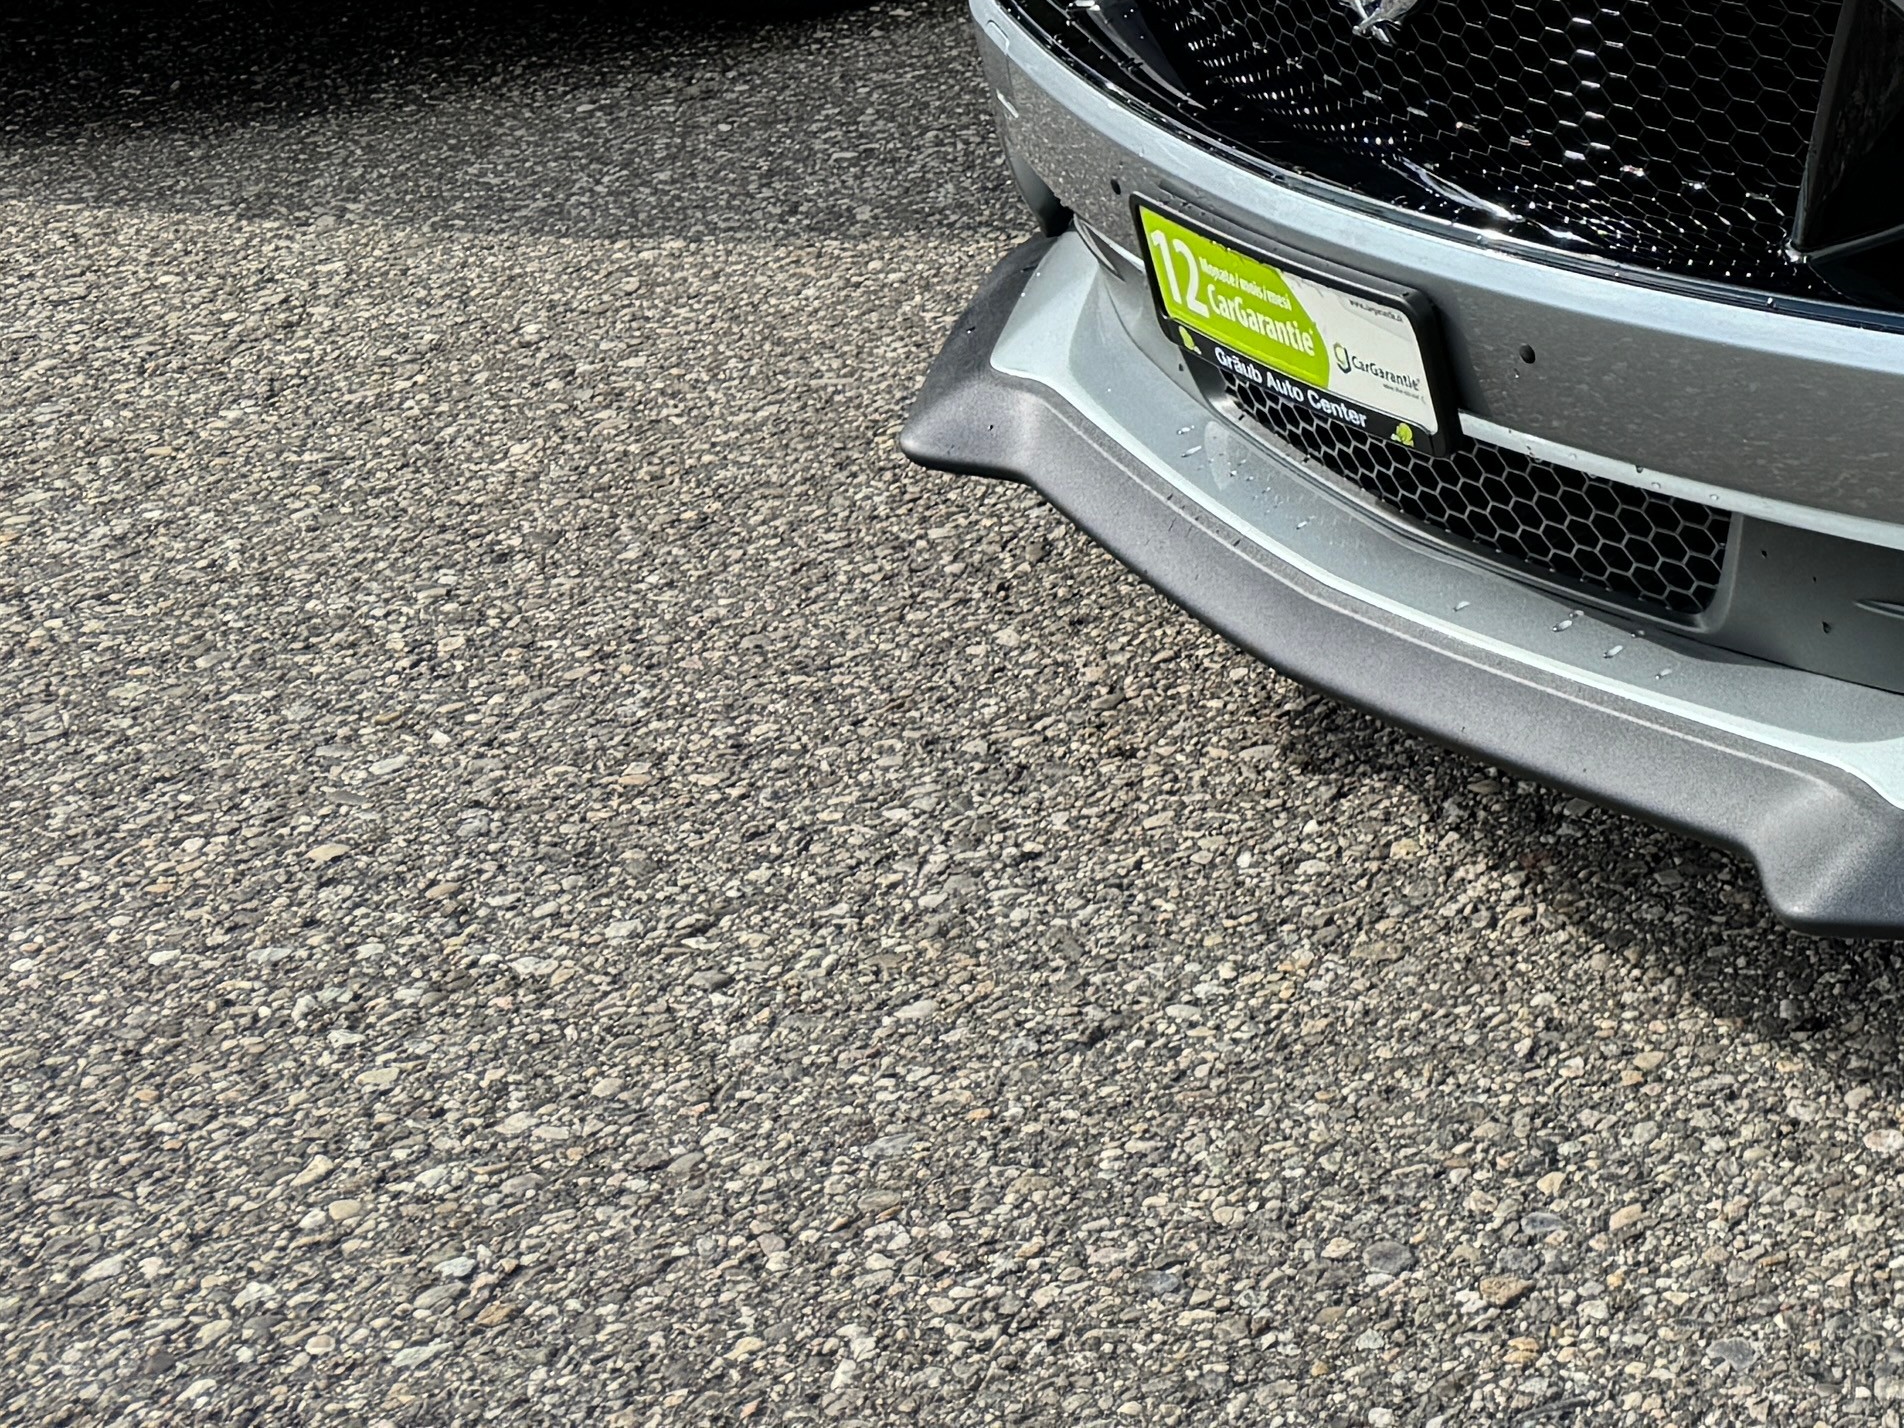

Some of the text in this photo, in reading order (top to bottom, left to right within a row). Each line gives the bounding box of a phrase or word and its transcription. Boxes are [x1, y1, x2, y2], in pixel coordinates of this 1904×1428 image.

[1150, 230, 1210, 318] 12
[1215, 346, 1262, 384] Gräub
[1266, 371, 1304, 402] Auto
[1307, 392, 1367, 428] Center
